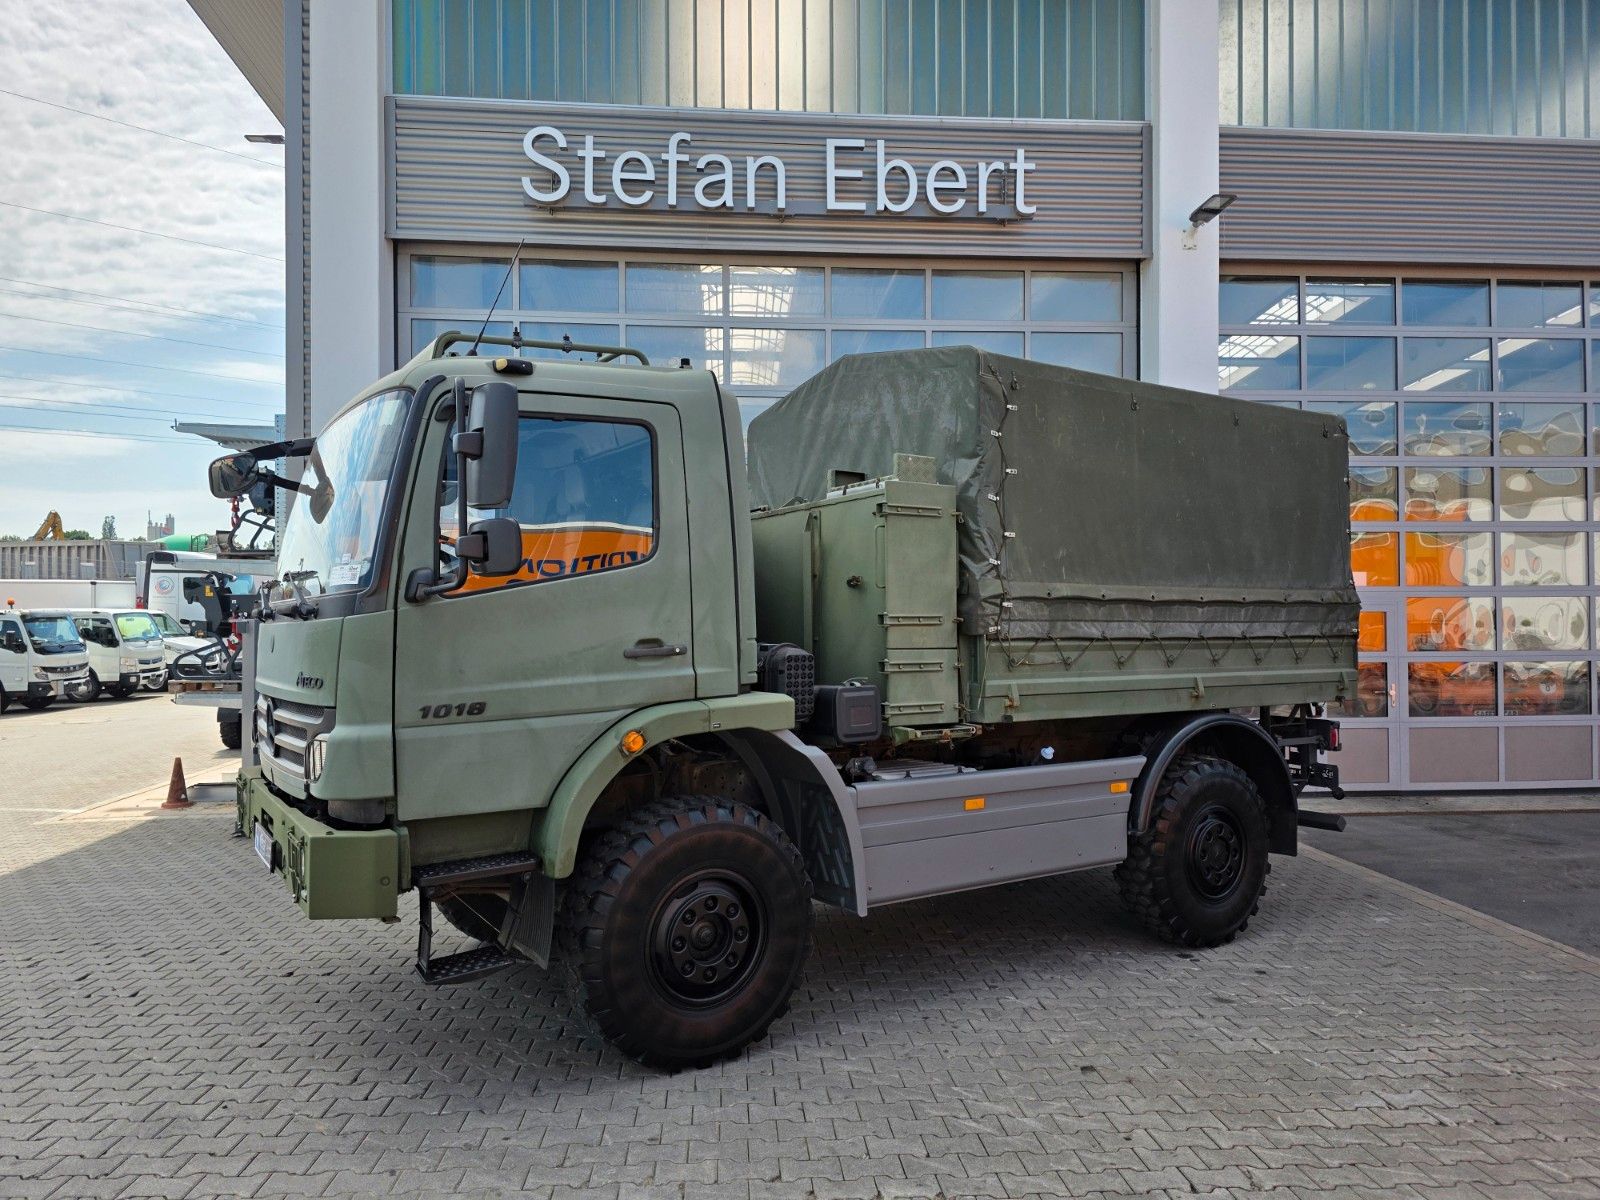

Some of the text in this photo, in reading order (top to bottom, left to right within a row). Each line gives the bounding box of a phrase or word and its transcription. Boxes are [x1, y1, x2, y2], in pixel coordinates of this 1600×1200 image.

[521, 125, 1037, 215] Stefan Ebert
[418, 701, 488, 720] 1018
